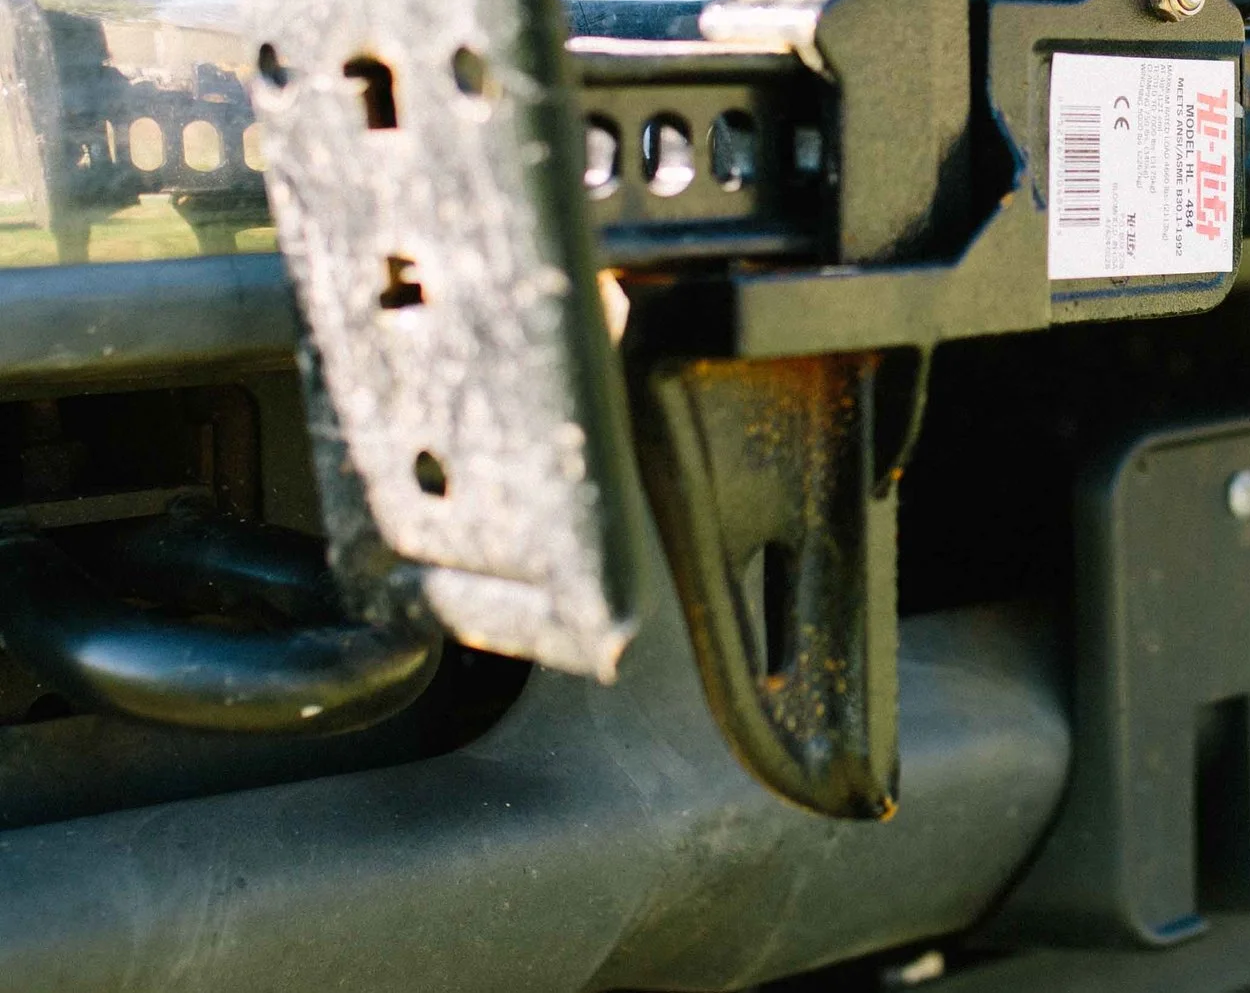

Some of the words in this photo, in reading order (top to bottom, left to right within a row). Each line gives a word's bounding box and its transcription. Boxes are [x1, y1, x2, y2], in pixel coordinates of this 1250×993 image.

[1176, 77, 1184, 116] MEETS
[1185, 105, 1194, 158] MODEL
[1185, 164, 1194, 183] HL
[1196, 89, 1228, 241] Hi-Lift
[1185, 200, 1193, 228] 484
